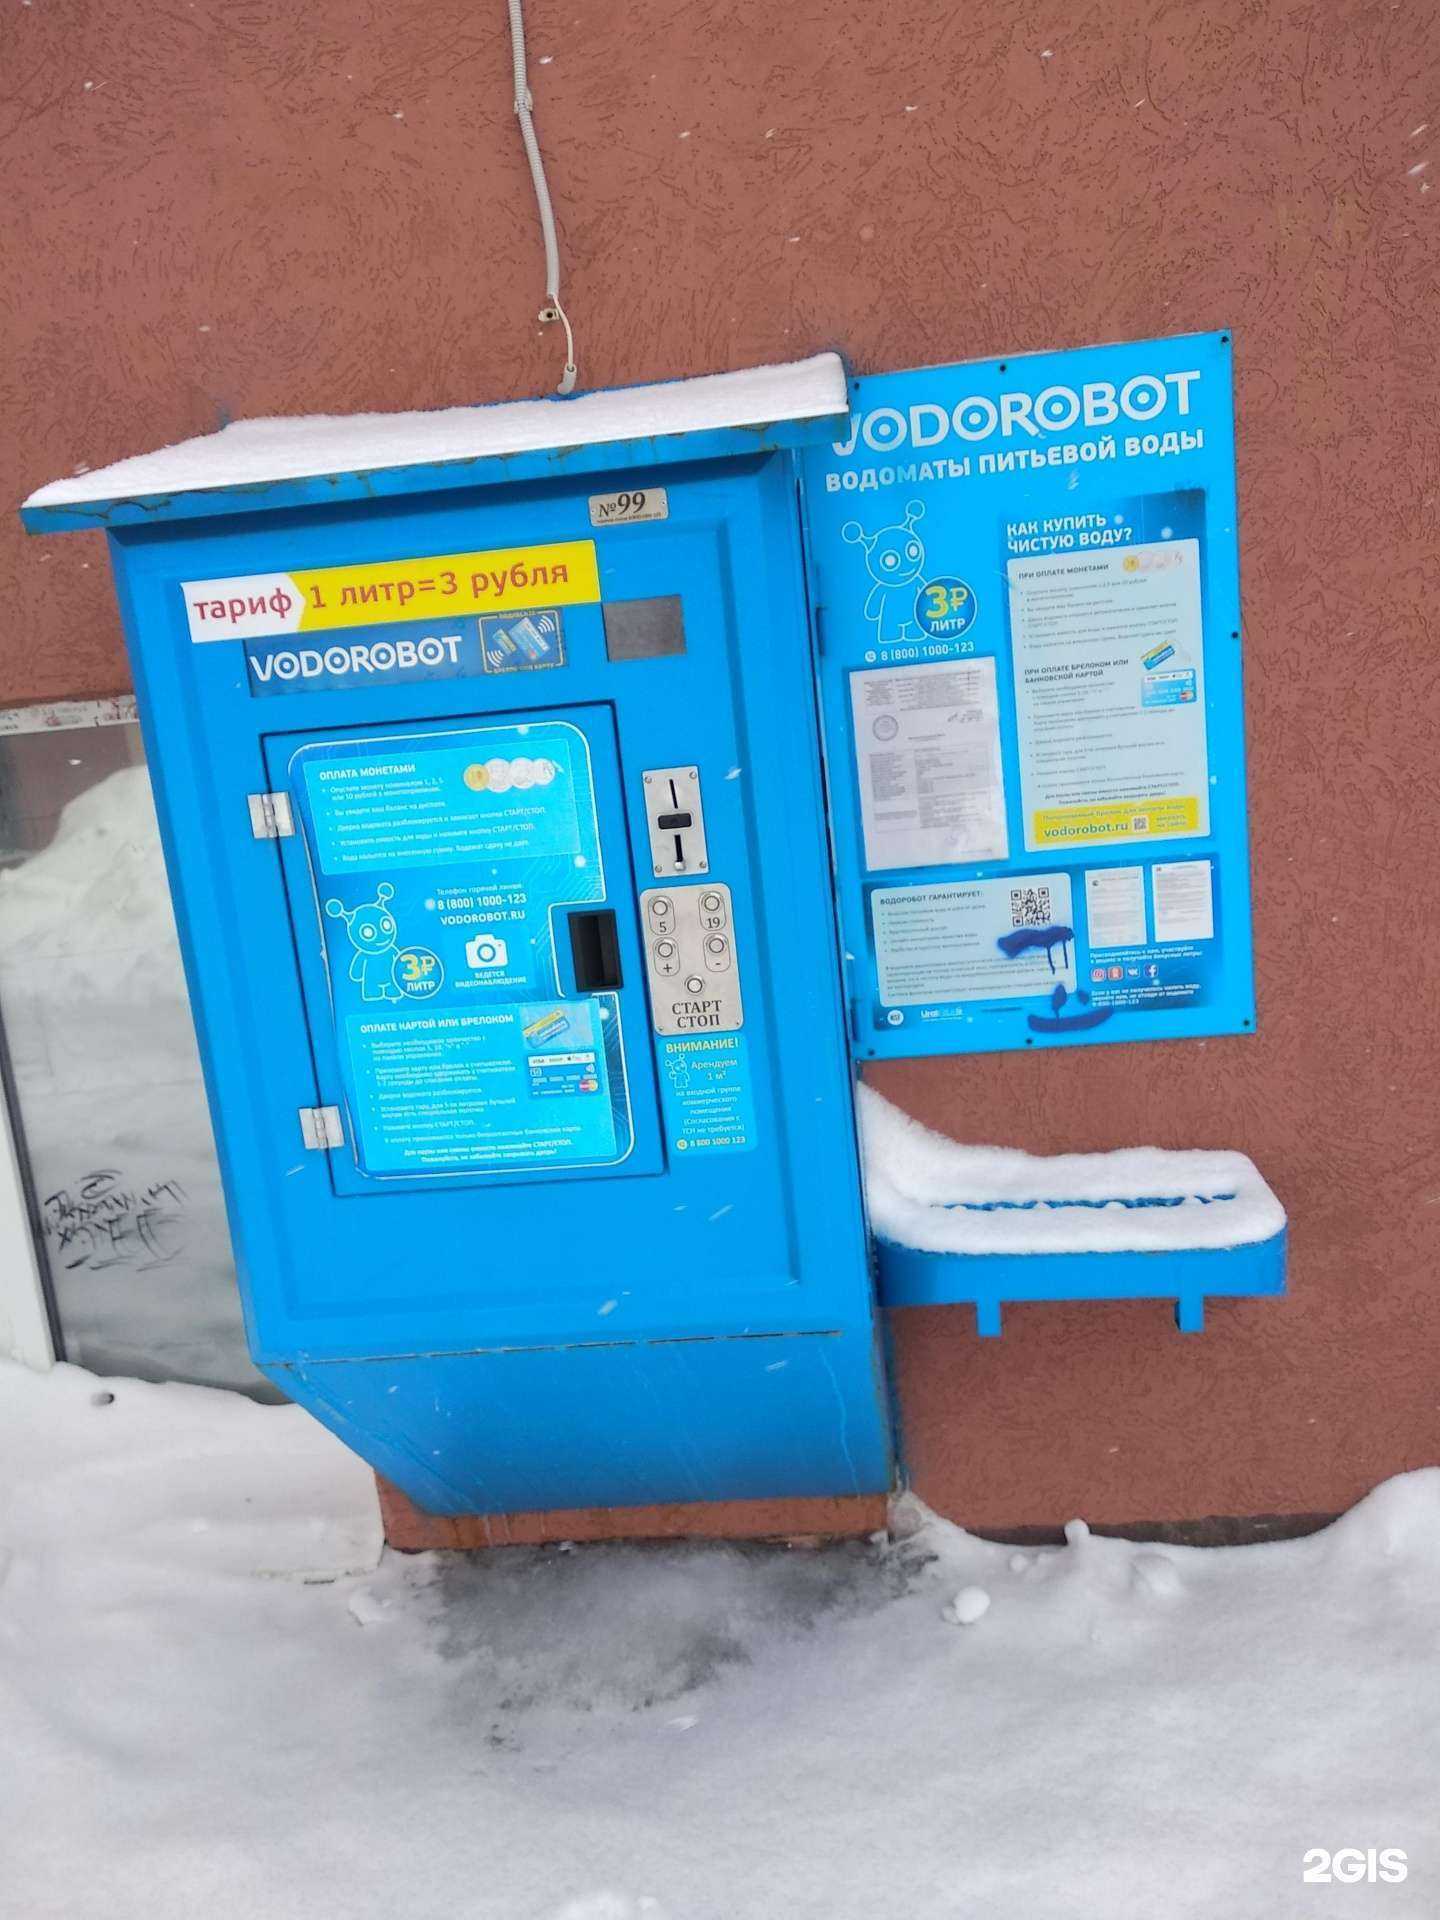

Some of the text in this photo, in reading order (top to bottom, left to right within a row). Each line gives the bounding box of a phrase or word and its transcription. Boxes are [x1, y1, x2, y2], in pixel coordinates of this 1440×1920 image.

[826, 429, 1204, 492] ВОДОМАТЫ ПИТЬЕВОЙ ВОДЫ
[1007, 514, 1107, 537] КАК КУПИТЬ
[1007, 527, 1133, 553] ЧИСТУЮ ВОДУ?
[1018, 564, 1109, 580] ПРИ ОПЛАТЕ МОНЕТАМИ
[193, 588, 292, 624] тариф
[310, 584, 327, 609] 1
[471, 562, 569, 598] рубля
[930, 617, 966, 632] ЛИТР
[250, 635, 462, 682] VODOROBOT
[881, 641, 975, 661] 8 (800) 1000-123
[1024, 667, 1039, 676] ПРИ
[1041, 665, 1070, 675] ОПЛАТЕ
[1071, 661, 1111, 671] БРЕЛОКОМ
[1025, 670, 1104, 684] БАНКОВСКОЙ КАРТОЙ
[319, 764, 416, 781] ОПЛАТА МОНЕТАМИ
[1044, 821, 1129, 838] vodorobot.ru
[437, 892, 527, 910] 8 (800) 1000-123
[880, 894, 927, 905] ВОДОРОБОТ
[440, 910, 526, 925] VODOROBOT.RU
[659, 917, 720, 933] 5 19
[406, 981, 436, 992] ЛИТР
[672, 999, 722, 1015] СТАРТ
[360, 1014, 514, 1034] ОПЛАТЕ КАРТОЙ ИЛИ БРЕЛОКОМ
[677, 1014, 720, 1029] СТОП
[666, 1037, 738, 1053] ВНИМАНИЕ!
[691, 1059, 738, 1070] Арендуем
[707, 1072, 713, 1081] 1
[717, 1086, 742, 1095] группе
[732, 1135, 746, 1144] 123
